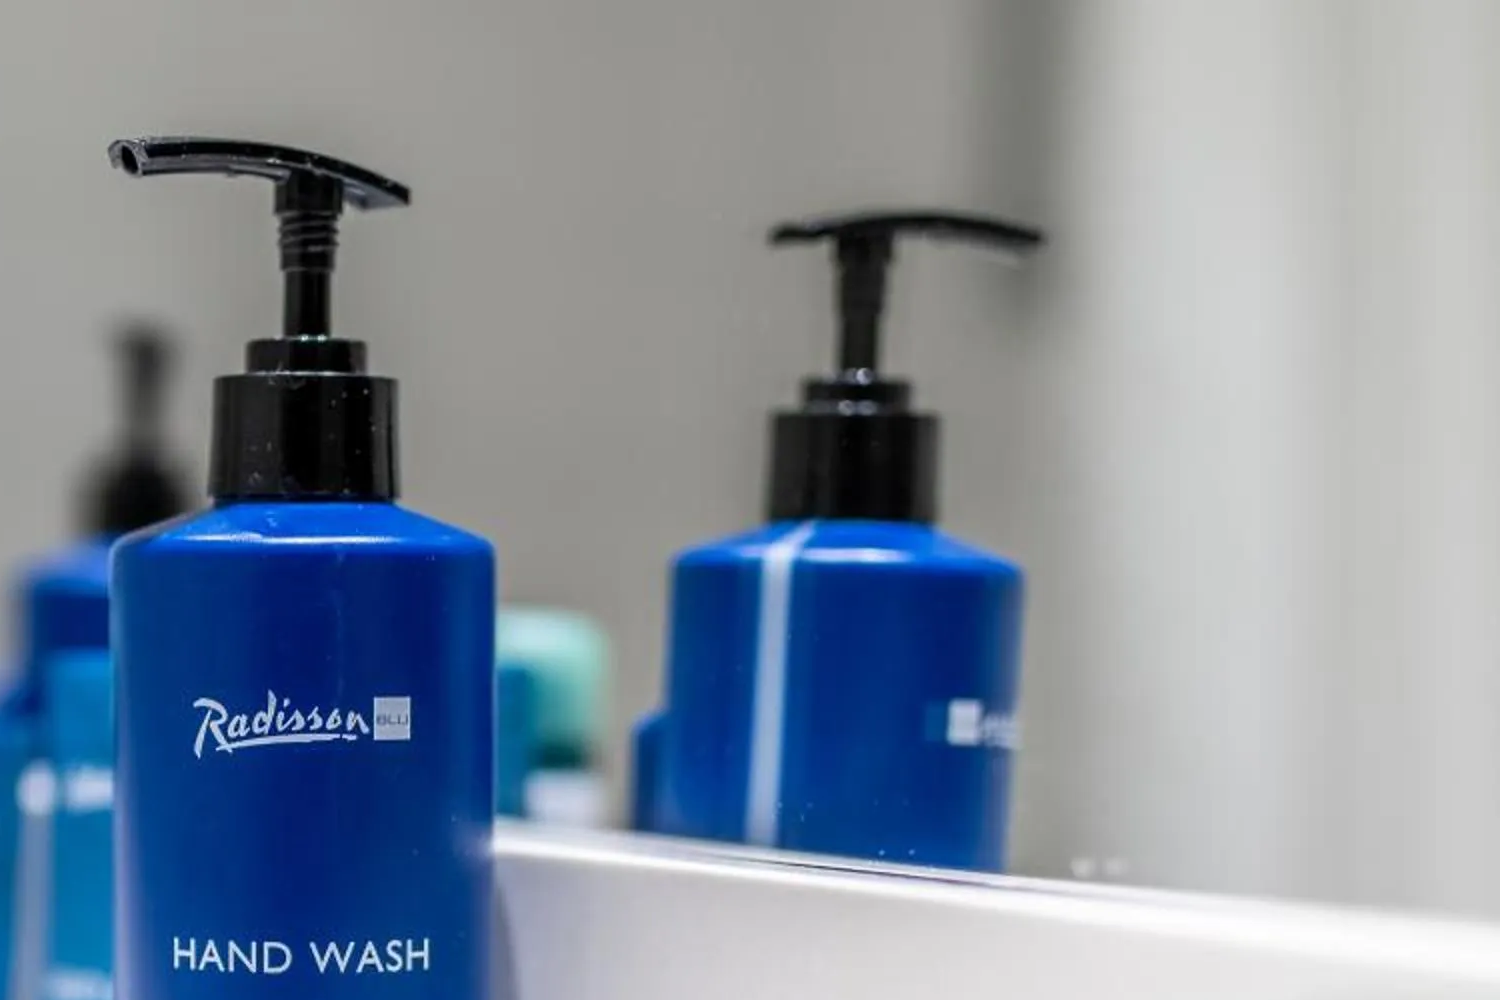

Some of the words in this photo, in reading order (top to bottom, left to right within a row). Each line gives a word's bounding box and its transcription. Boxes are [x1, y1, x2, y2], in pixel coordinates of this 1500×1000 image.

[193, 690, 369, 759] Radisson
[173, 938, 292, 973] HAND
[310, 938, 429, 973] WASH
